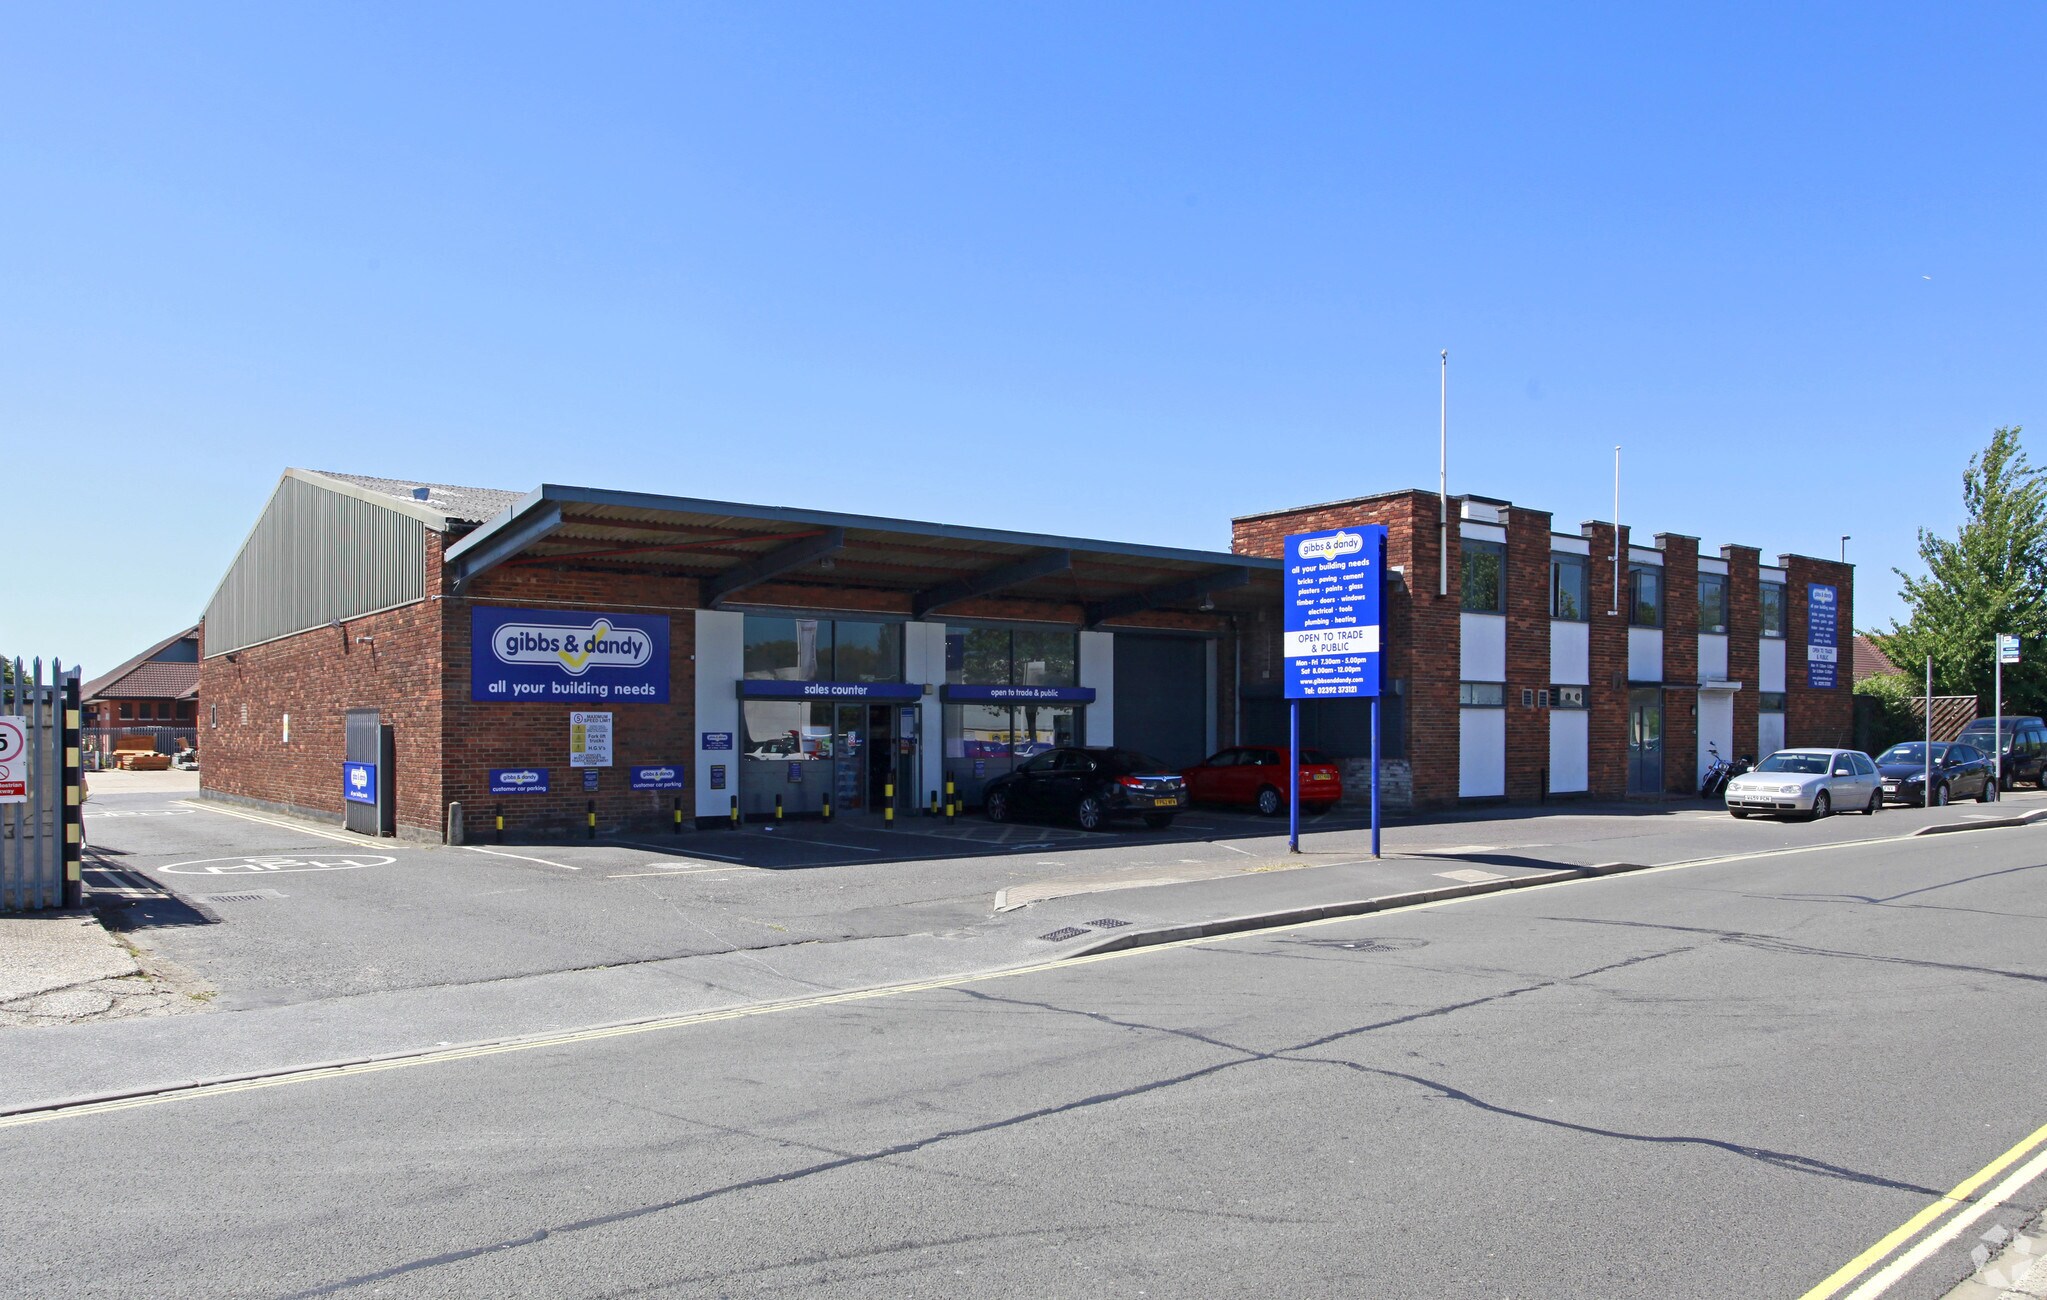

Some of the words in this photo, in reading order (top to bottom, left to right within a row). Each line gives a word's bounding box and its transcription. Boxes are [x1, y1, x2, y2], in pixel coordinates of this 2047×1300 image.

[1304, 544, 1324, 554] gibbs
[1326, 542, 1332, 550] &
[1334, 538, 1358, 548] dandy
[1302, 566, 1316, 574] your
[1318, 562, 1346, 571] building
[1348, 558, 1370, 566] needs
[1342, 572, 1364, 580] cement
[1298, 588, 1320, 596] plasters
[1325, 585, 1343, 594] paints
[1348, 583, 1363, 592] glass
[1308, 606, 1334, 615] electrical
[1304, 618, 1330, 627] plumbing
[1334, 616, 1356, 624] heating
[1298, 634, 1320, 643] OPEN
[1324, 632, 1333, 641] TO
[1338, 630, 1363, 640] TRADE
[506, 632, 560, 655] gibbs
[564, 635, 578, 652] &
[584, 636, 642, 660] dandy
[1312, 644, 1317, 652] &
[1321, 642, 1349, 652] PUBLIC
[488, 680, 506, 693] all
[513, 683, 545, 696] your
[552, 682, 608, 697] building
[614, 683, 656, 696] needs
[804, 684, 829, 694] sales
[832, 685, 868, 694] counter
[1040, 689, 1058, 698] public
